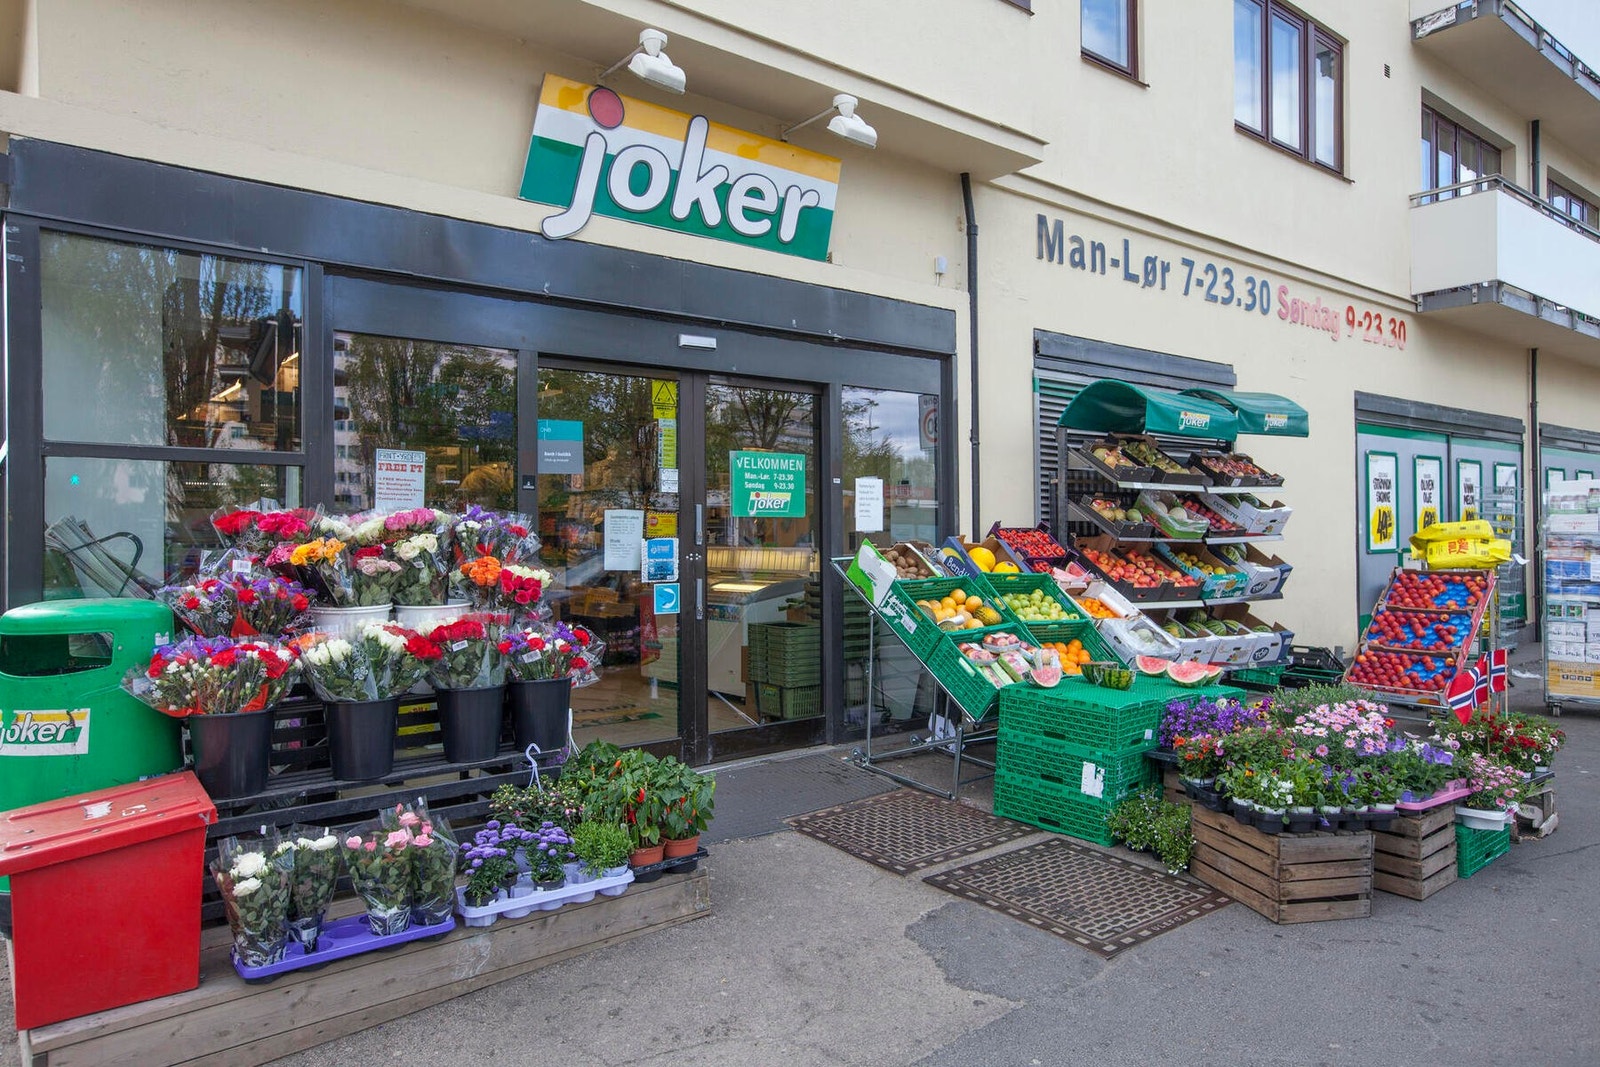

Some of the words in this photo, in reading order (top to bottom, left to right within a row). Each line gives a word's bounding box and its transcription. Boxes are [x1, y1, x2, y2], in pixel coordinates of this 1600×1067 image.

[541, 85, 820, 243] joker
[1036, 213, 1170, 290] Man-Lør
[1181, 257, 1271, 316] 7-23.30
[1277, 285, 1340, 341] Søndag
[1345, 305, 1407, 350] 9-23.30
[1179, 411, 1206, 430] joker
[1264, 413, 1286, 431] joker
[378, 463, 407, 472] FREE
[736, 457, 803, 471] VELKOMMEN
[744, 482, 765, 490] Søndag
[749, 492, 790, 516] joker
